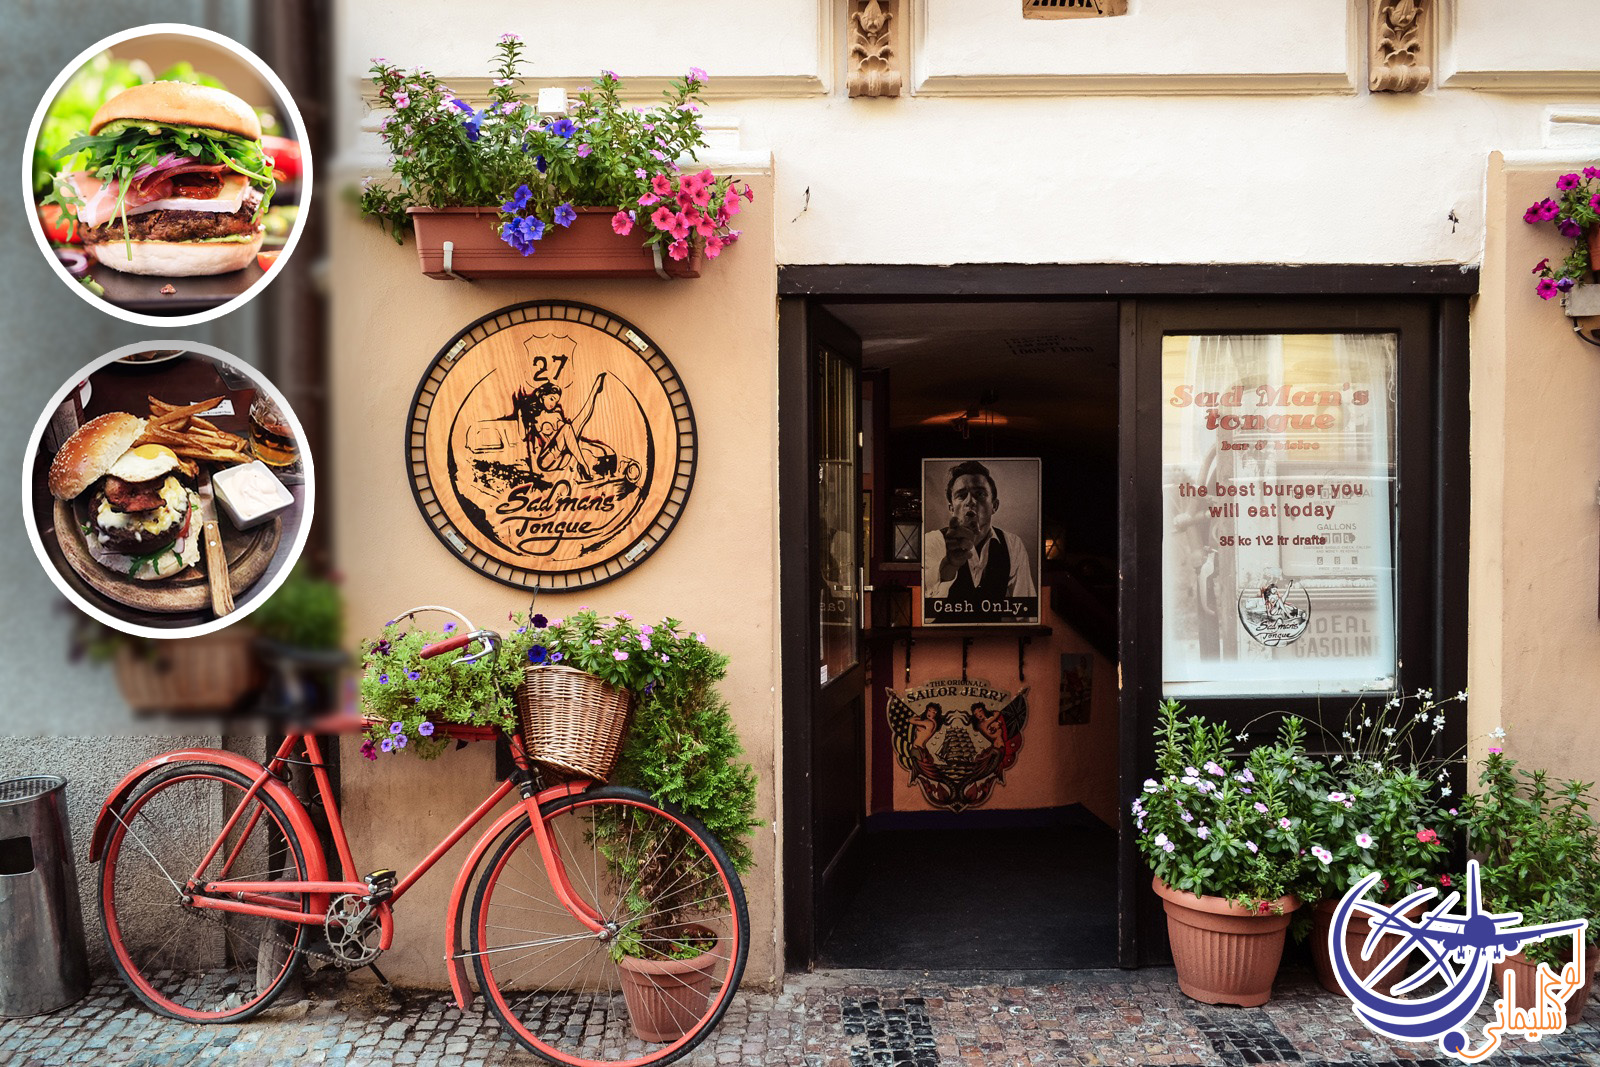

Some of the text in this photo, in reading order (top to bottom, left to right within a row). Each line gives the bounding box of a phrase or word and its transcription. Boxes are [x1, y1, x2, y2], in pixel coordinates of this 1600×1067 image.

[533, 354, 568, 381] 27
[1169, 382, 1370, 408] Sad Man's
[1205, 408, 1335, 433] tongue
[1221, 441, 1249, 451] bar
[1274, 440, 1320, 451] bistro
[496, 480, 615, 514] Sad man's
[1178, 483, 1208, 497] the
[1216, 482, 1255, 497] best
[1263, 482, 1324, 499] burger
[1330, 483, 1364, 499] you
[1209, 502, 1335, 520] will eat today
[500, 513, 606, 556] Tongue
[1316, 523, 1357, 531] GALLONS
[1219, 536, 1235, 547] 35
[1255, 536, 1274, 546] 1\2
[1292, 535, 1326, 546] drafts
[934, 600, 1028, 615] Cash Only.
[930, 679, 983, 688] THE ORIGINAL
[906, 686, 1008, 703] SAILOR JERRY
